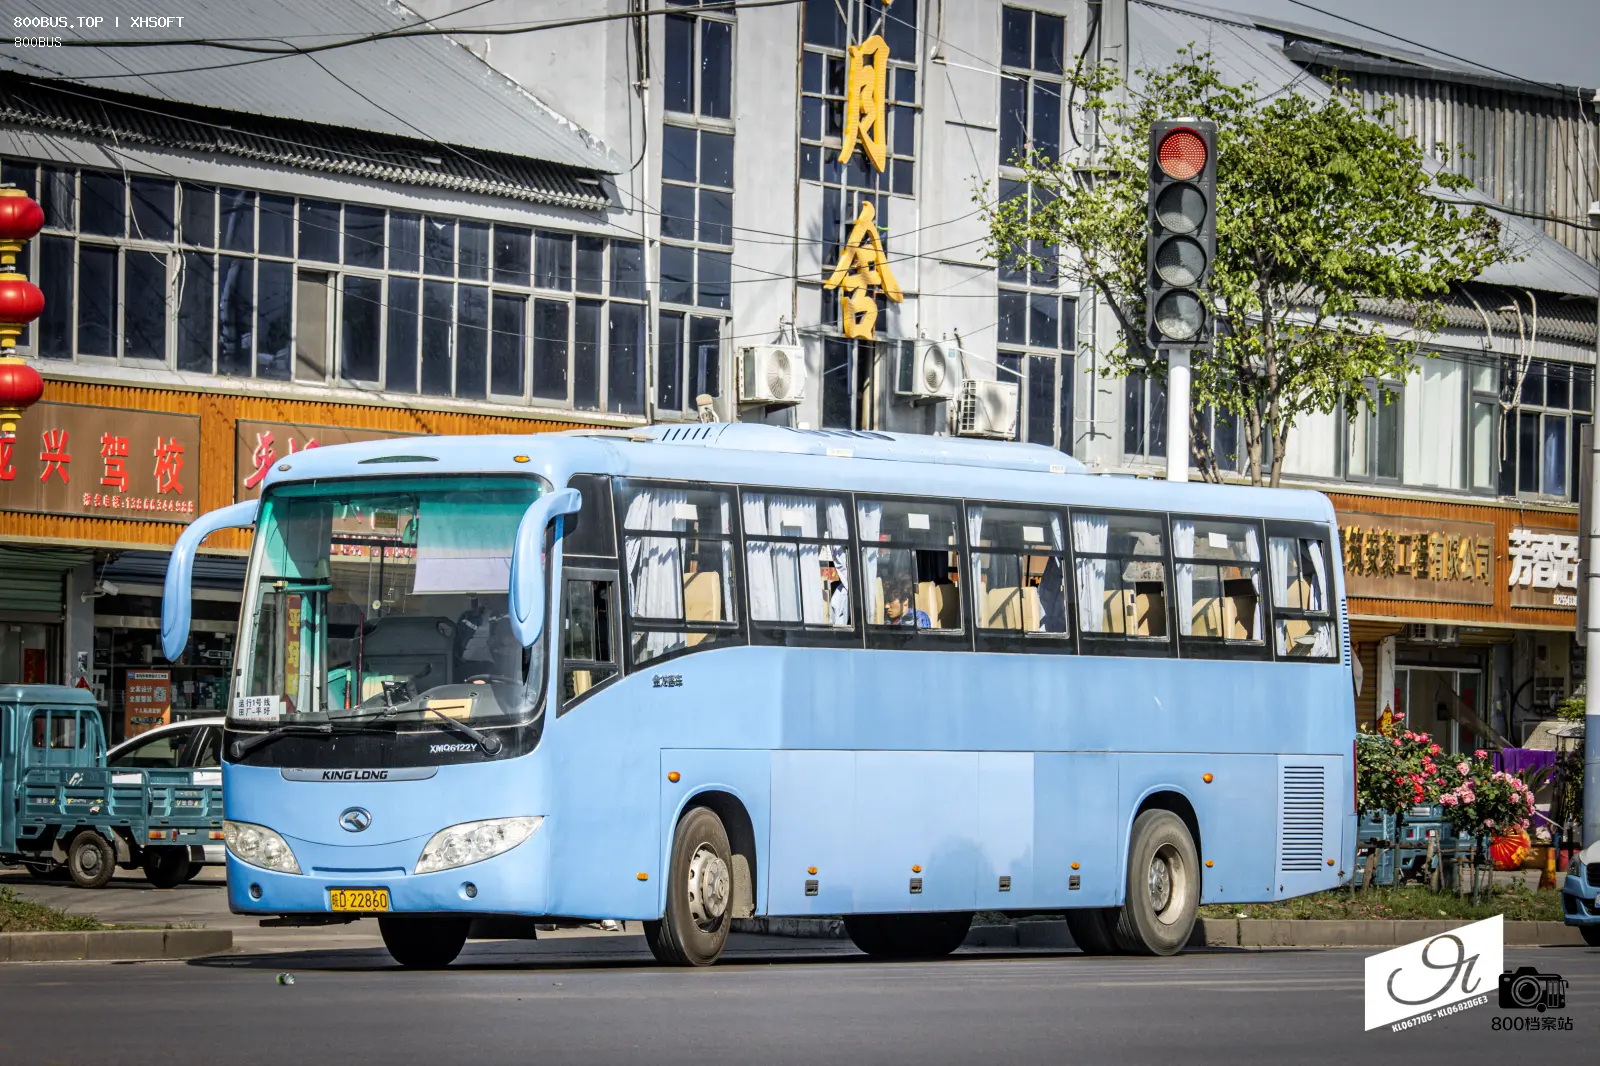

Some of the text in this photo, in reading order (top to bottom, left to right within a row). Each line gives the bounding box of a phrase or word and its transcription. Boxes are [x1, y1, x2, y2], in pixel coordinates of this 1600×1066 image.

[1338, 526, 1491, 585] 筑安装工程有限公司
[429, 743, 478, 754] XMQ6122Y
[322, 770, 388, 780] KING LONG
